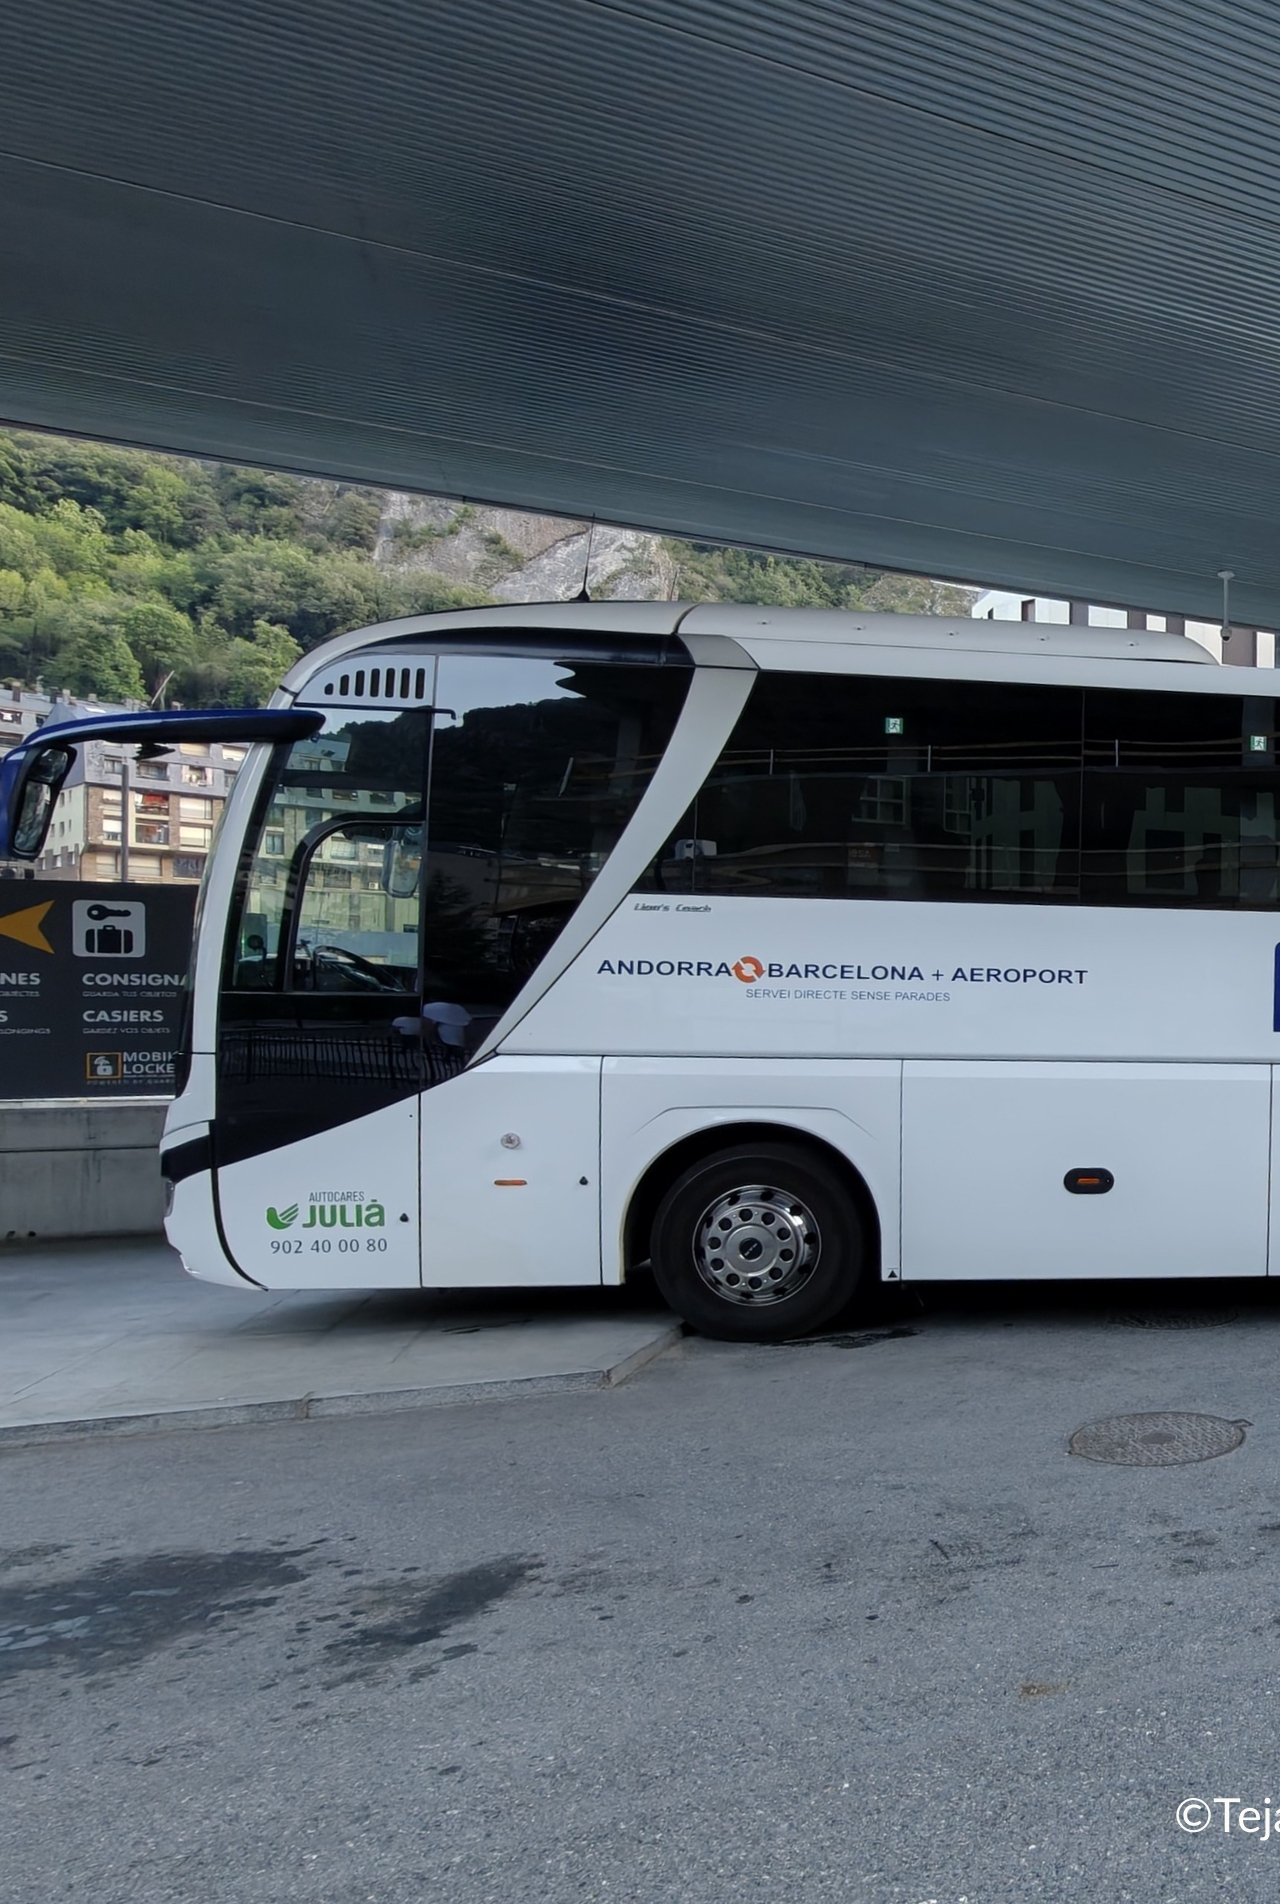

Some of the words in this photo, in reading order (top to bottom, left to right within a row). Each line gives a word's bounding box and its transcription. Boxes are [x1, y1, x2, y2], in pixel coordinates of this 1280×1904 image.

[597, 959, 733, 977] ANDORRA
[768, 963, 925, 981] BARCELONA
[931, 969, 945, 982] +
[951, 967, 1089, 985] AEROPORT
[745, 988, 791, 999] SERVEI
[794, 989, 847, 1000] DIRECTE
[850, 990, 891, 1001] SENSE
[894, 991, 951, 1002] PARADES
[82, 1009, 164, 1023] CASIERS
[308, 1190, 365, 1203] AUTOCARES
[270, 1239, 303, 1255] 902
[310, 1239, 332, 1254] 40
[338, 1238, 360, 1253] 00
[366, 1237, 388, 1253] 80
